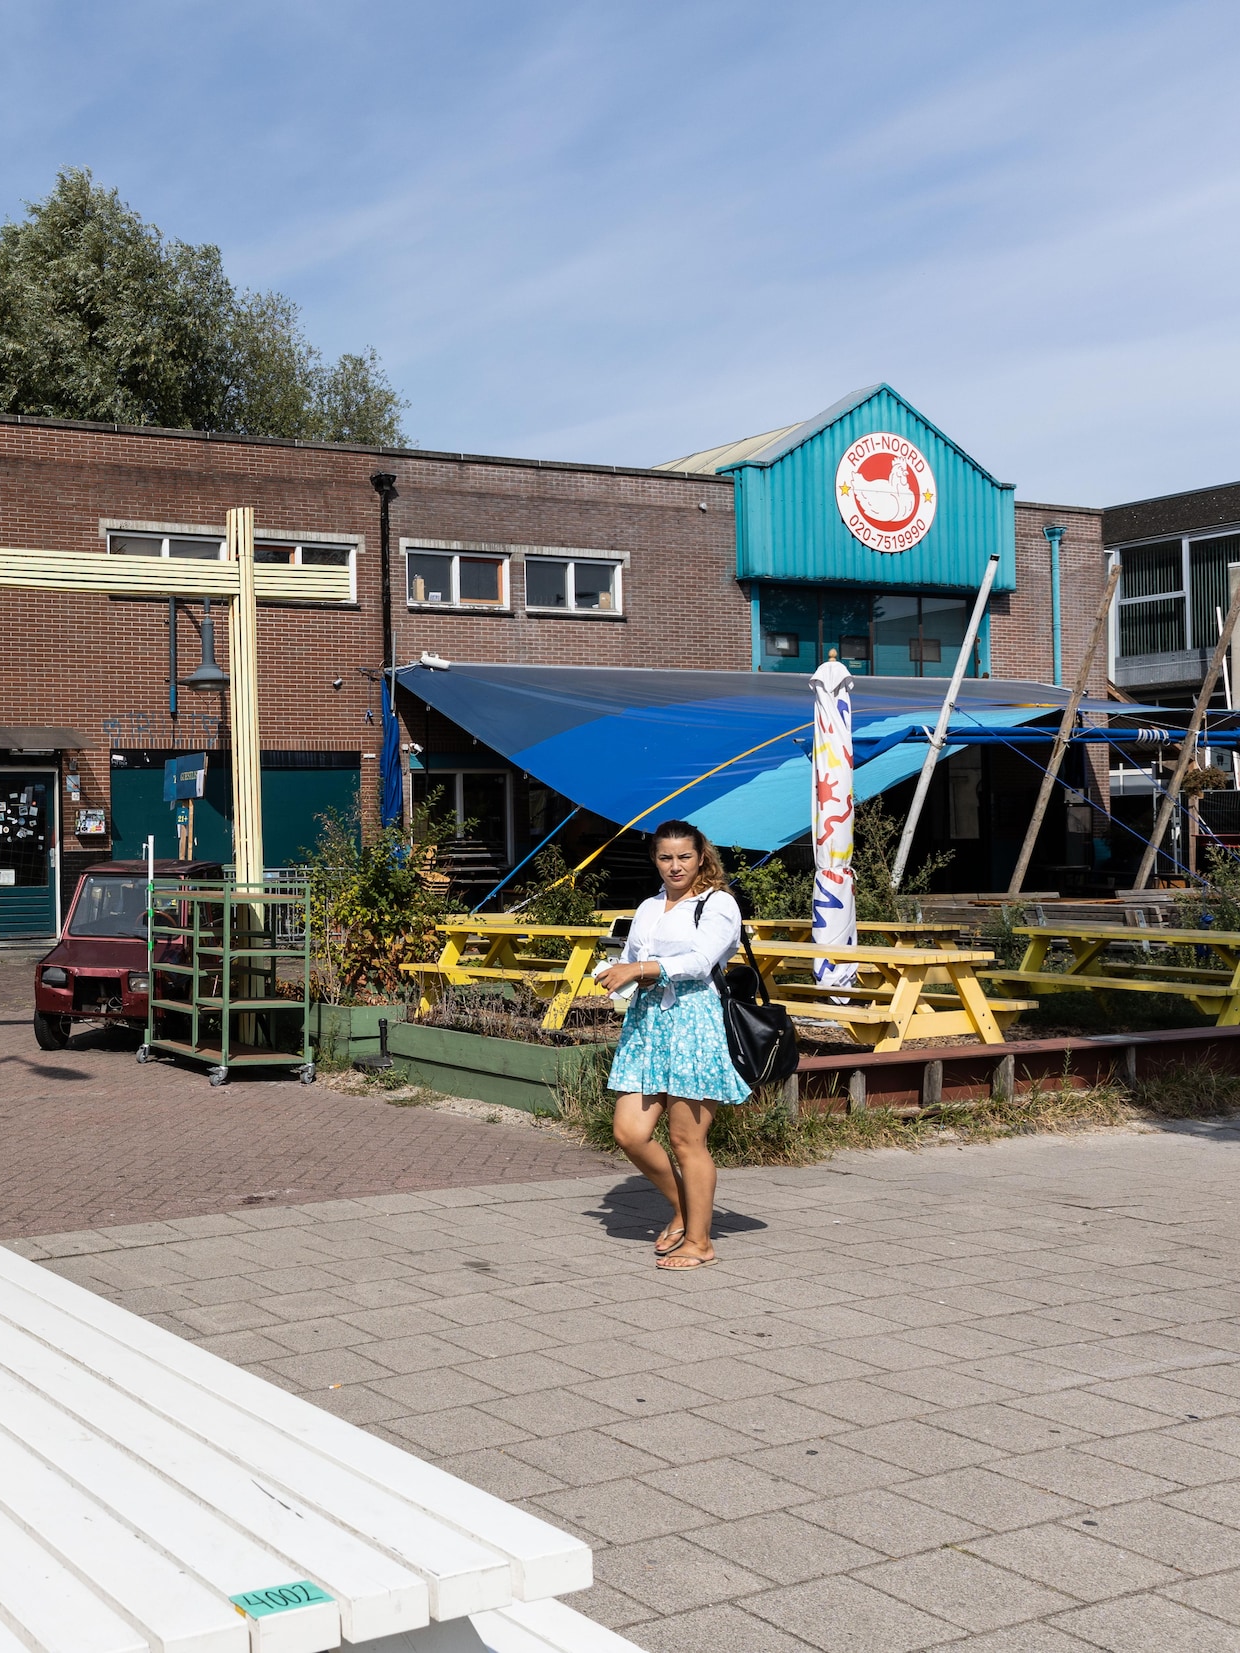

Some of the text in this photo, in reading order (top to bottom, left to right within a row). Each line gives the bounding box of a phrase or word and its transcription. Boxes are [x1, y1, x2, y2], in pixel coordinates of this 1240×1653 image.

[847, 436, 925, 473] ROTI-NOORD
[849, 514, 926, 549] 020-7519990
[177, 815, 188, 823] 21+
[243, 1584, 323, 1609] 4002
